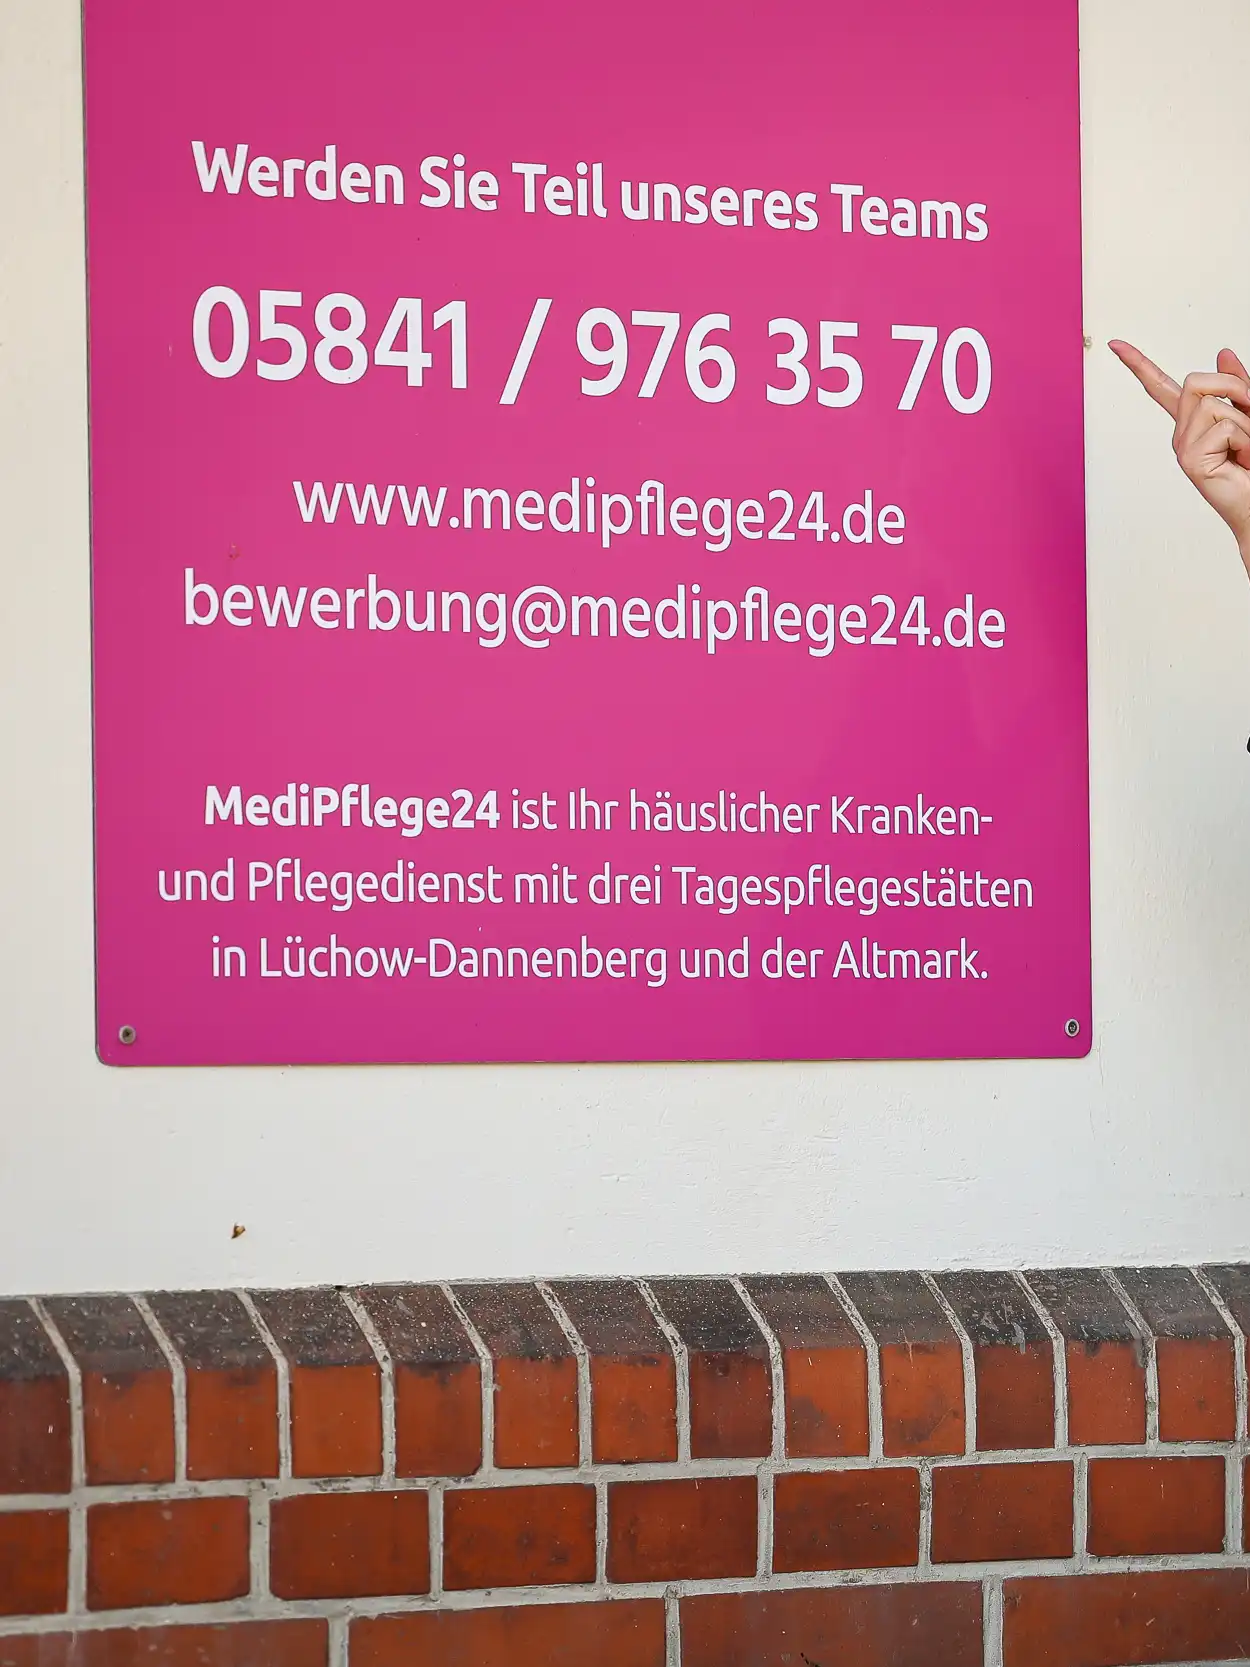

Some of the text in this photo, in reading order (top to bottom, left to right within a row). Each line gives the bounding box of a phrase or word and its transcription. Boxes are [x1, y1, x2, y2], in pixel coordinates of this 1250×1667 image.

[191, 140, 989, 242] Werden Sie Teil unseres Teams
[192, 285, 992, 415] 05841 / 976 35 70
[292, 476, 906, 553] www.medipflege24.de
[184, 567, 1006, 658] bewerbung@medipflege24.de
[204, 782, 993, 838] MediPflege24 ist Ihr häuslicher Kranken-
[158, 857, 1033, 916] und Pflegedienst mit drei Tagespflegestätten
[212, 933, 988, 988] in Lüchow-Dannenberg und der Altmark.
